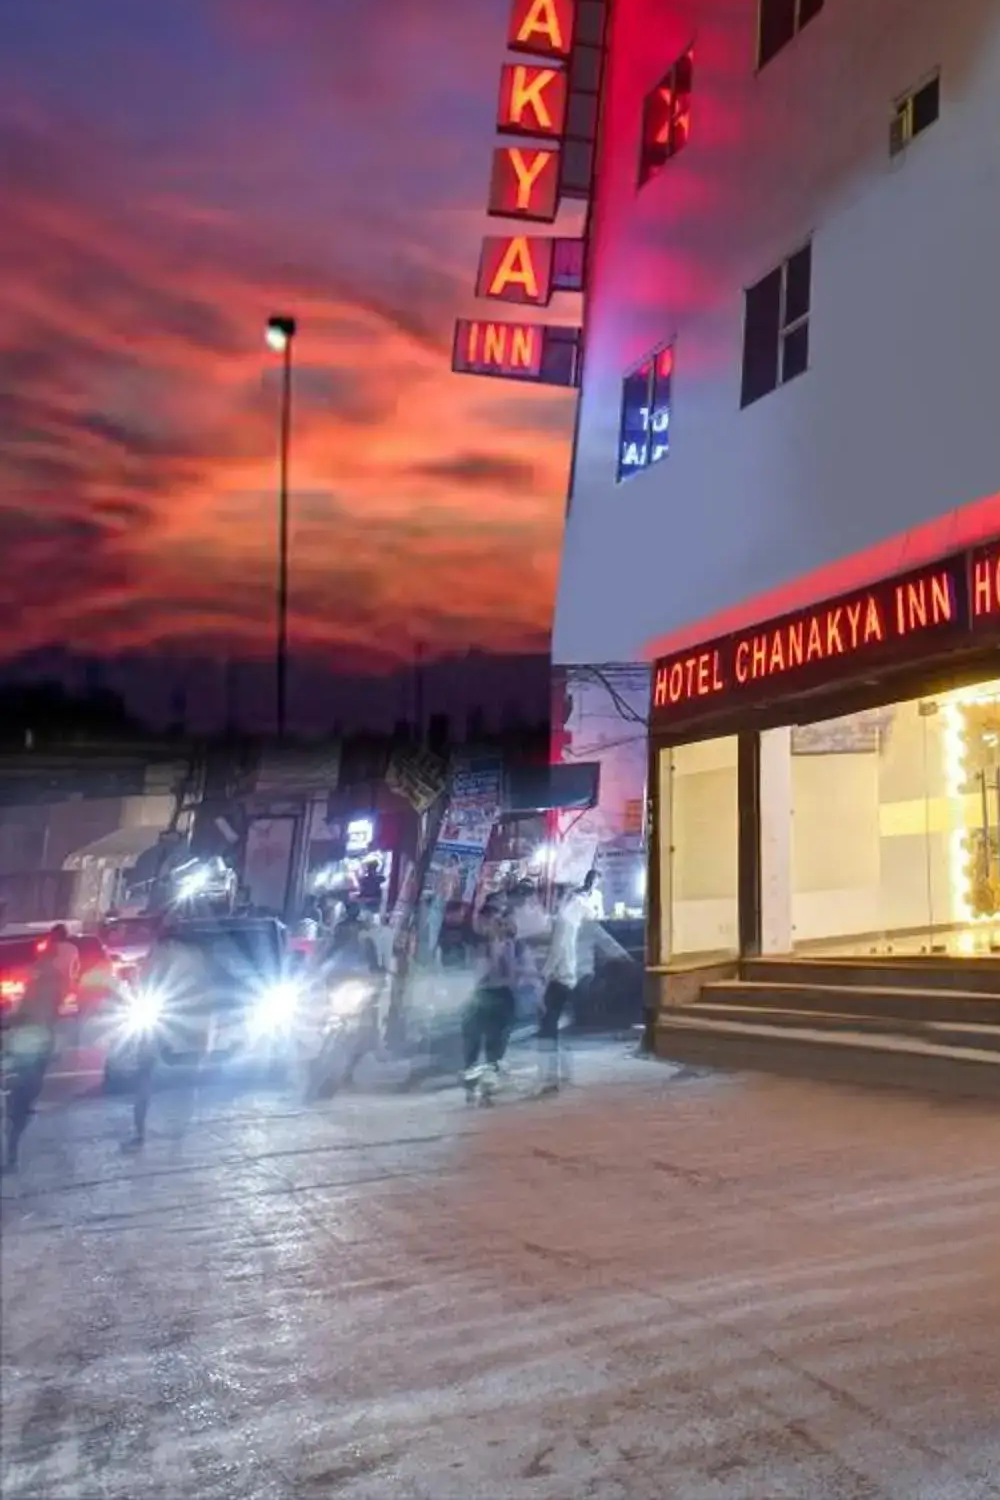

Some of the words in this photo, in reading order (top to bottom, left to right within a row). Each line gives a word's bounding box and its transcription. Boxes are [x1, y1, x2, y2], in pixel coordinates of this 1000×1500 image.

[466, 322, 533, 367] INN
[654, 649, 724, 706] HOTEL
[734, 595, 883, 684] CHANAKYA
[895, 571, 952, 635] INN
